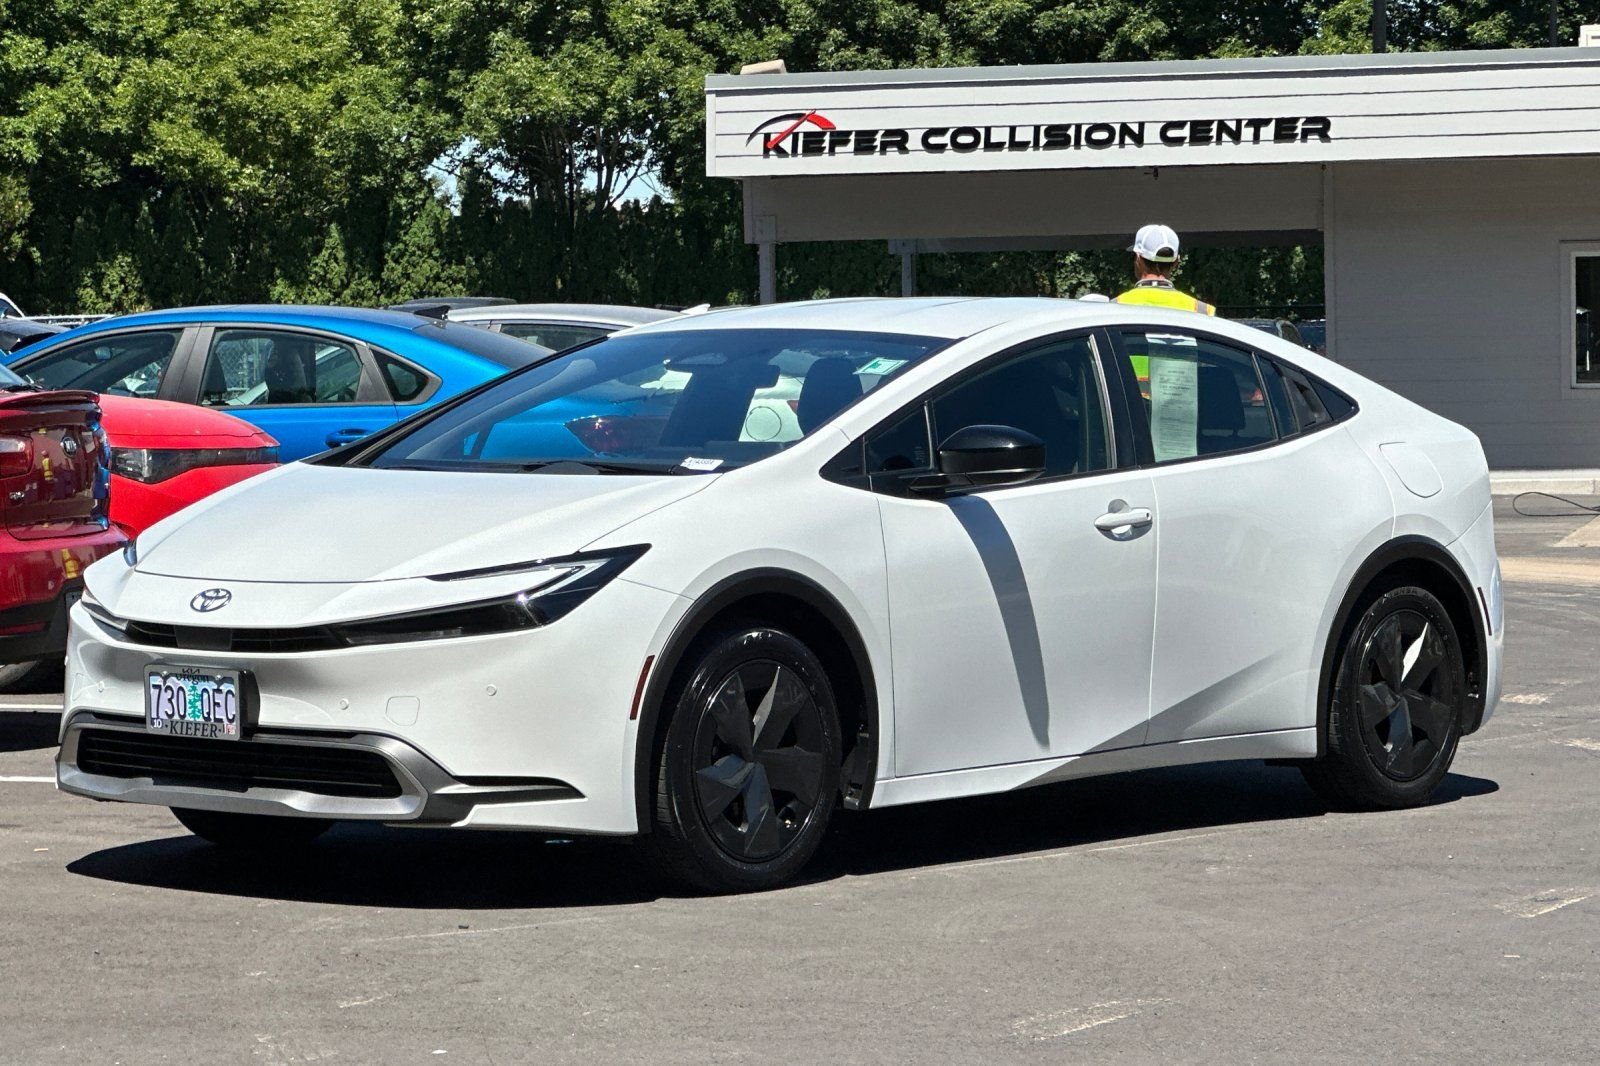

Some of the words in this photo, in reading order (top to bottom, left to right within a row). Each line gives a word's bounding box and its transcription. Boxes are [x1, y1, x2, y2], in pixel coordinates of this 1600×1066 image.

[763, 129, 909, 158] KIEFER
[921, 121, 1145, 154] COLLISION
[1159, 115, 1332, 148] CENTER
[151, 684, 187, 721] 730
[201, 687, 236, 724] QEC
[169, 720, 218, 738] KIEFER
